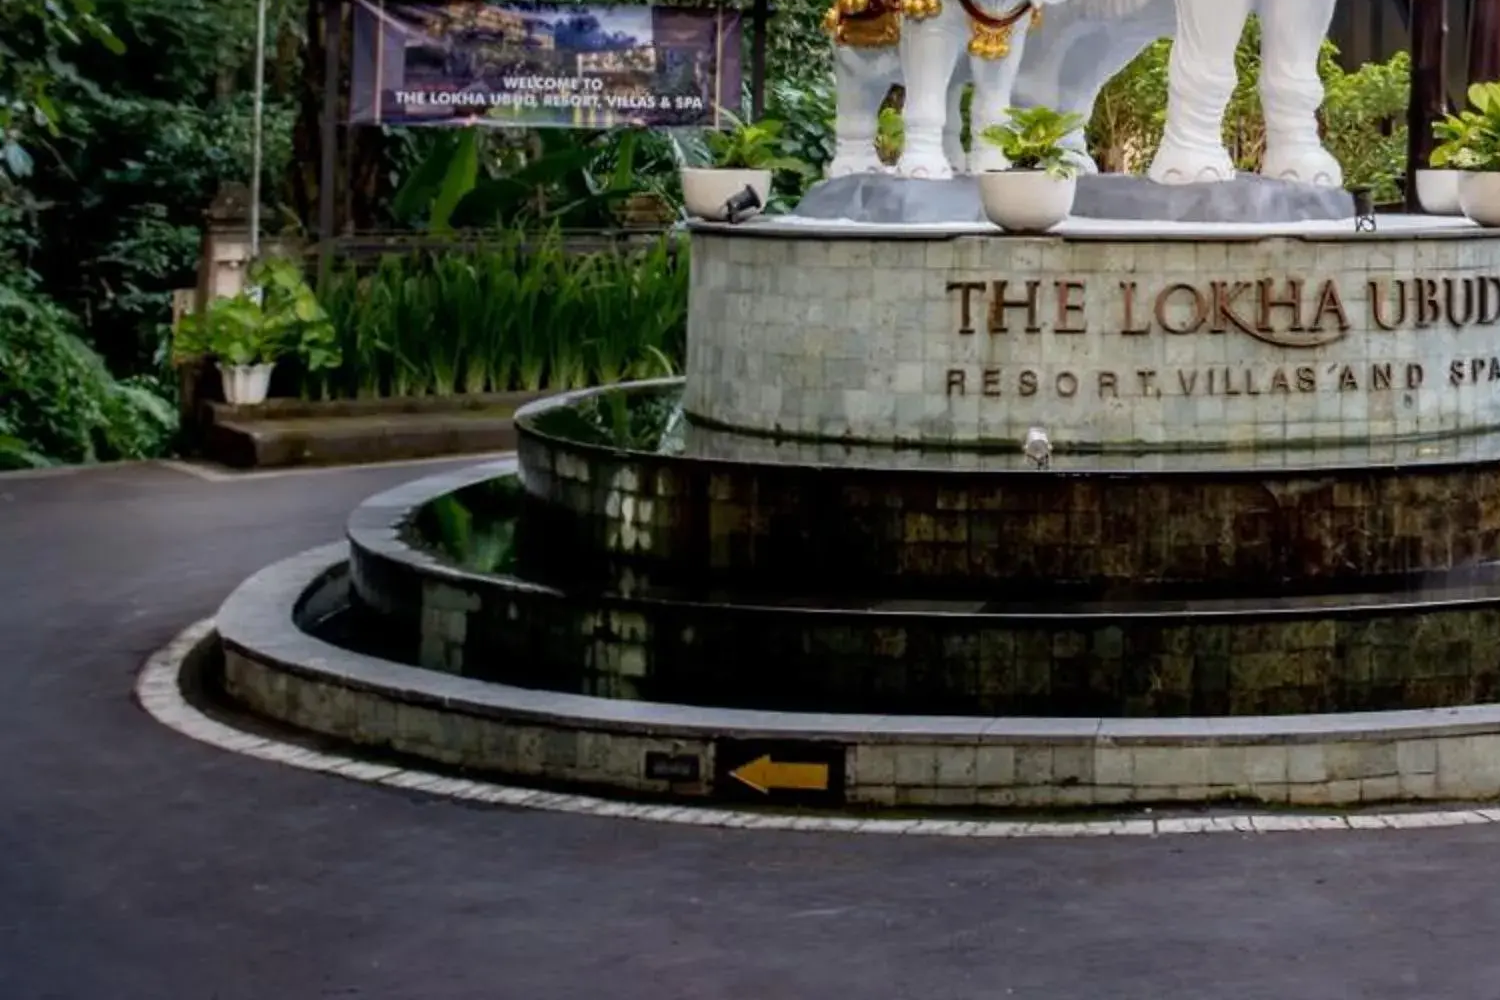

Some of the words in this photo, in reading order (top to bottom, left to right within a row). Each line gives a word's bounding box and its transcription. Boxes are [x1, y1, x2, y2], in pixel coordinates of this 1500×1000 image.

[503, 77, 577, 90] WELCOME
[584, 78, 603, 91] TO
[395, 91, 425, 104] THE
[430, 92, 486, 105] LOKHA
[606, 95, 655, 108] VILLAS
[660, 96, 671, 108] &
[675, 96, 702, 109] SPA
[946, 280, 1086, 334] THE
[1119, 278, 1352, 347] LOKHA
[946, 369, 1162, 400] RESORT,
[1177, 366, 1316, 396] VILLAS
[1338, 362, 1423, 393] AND
